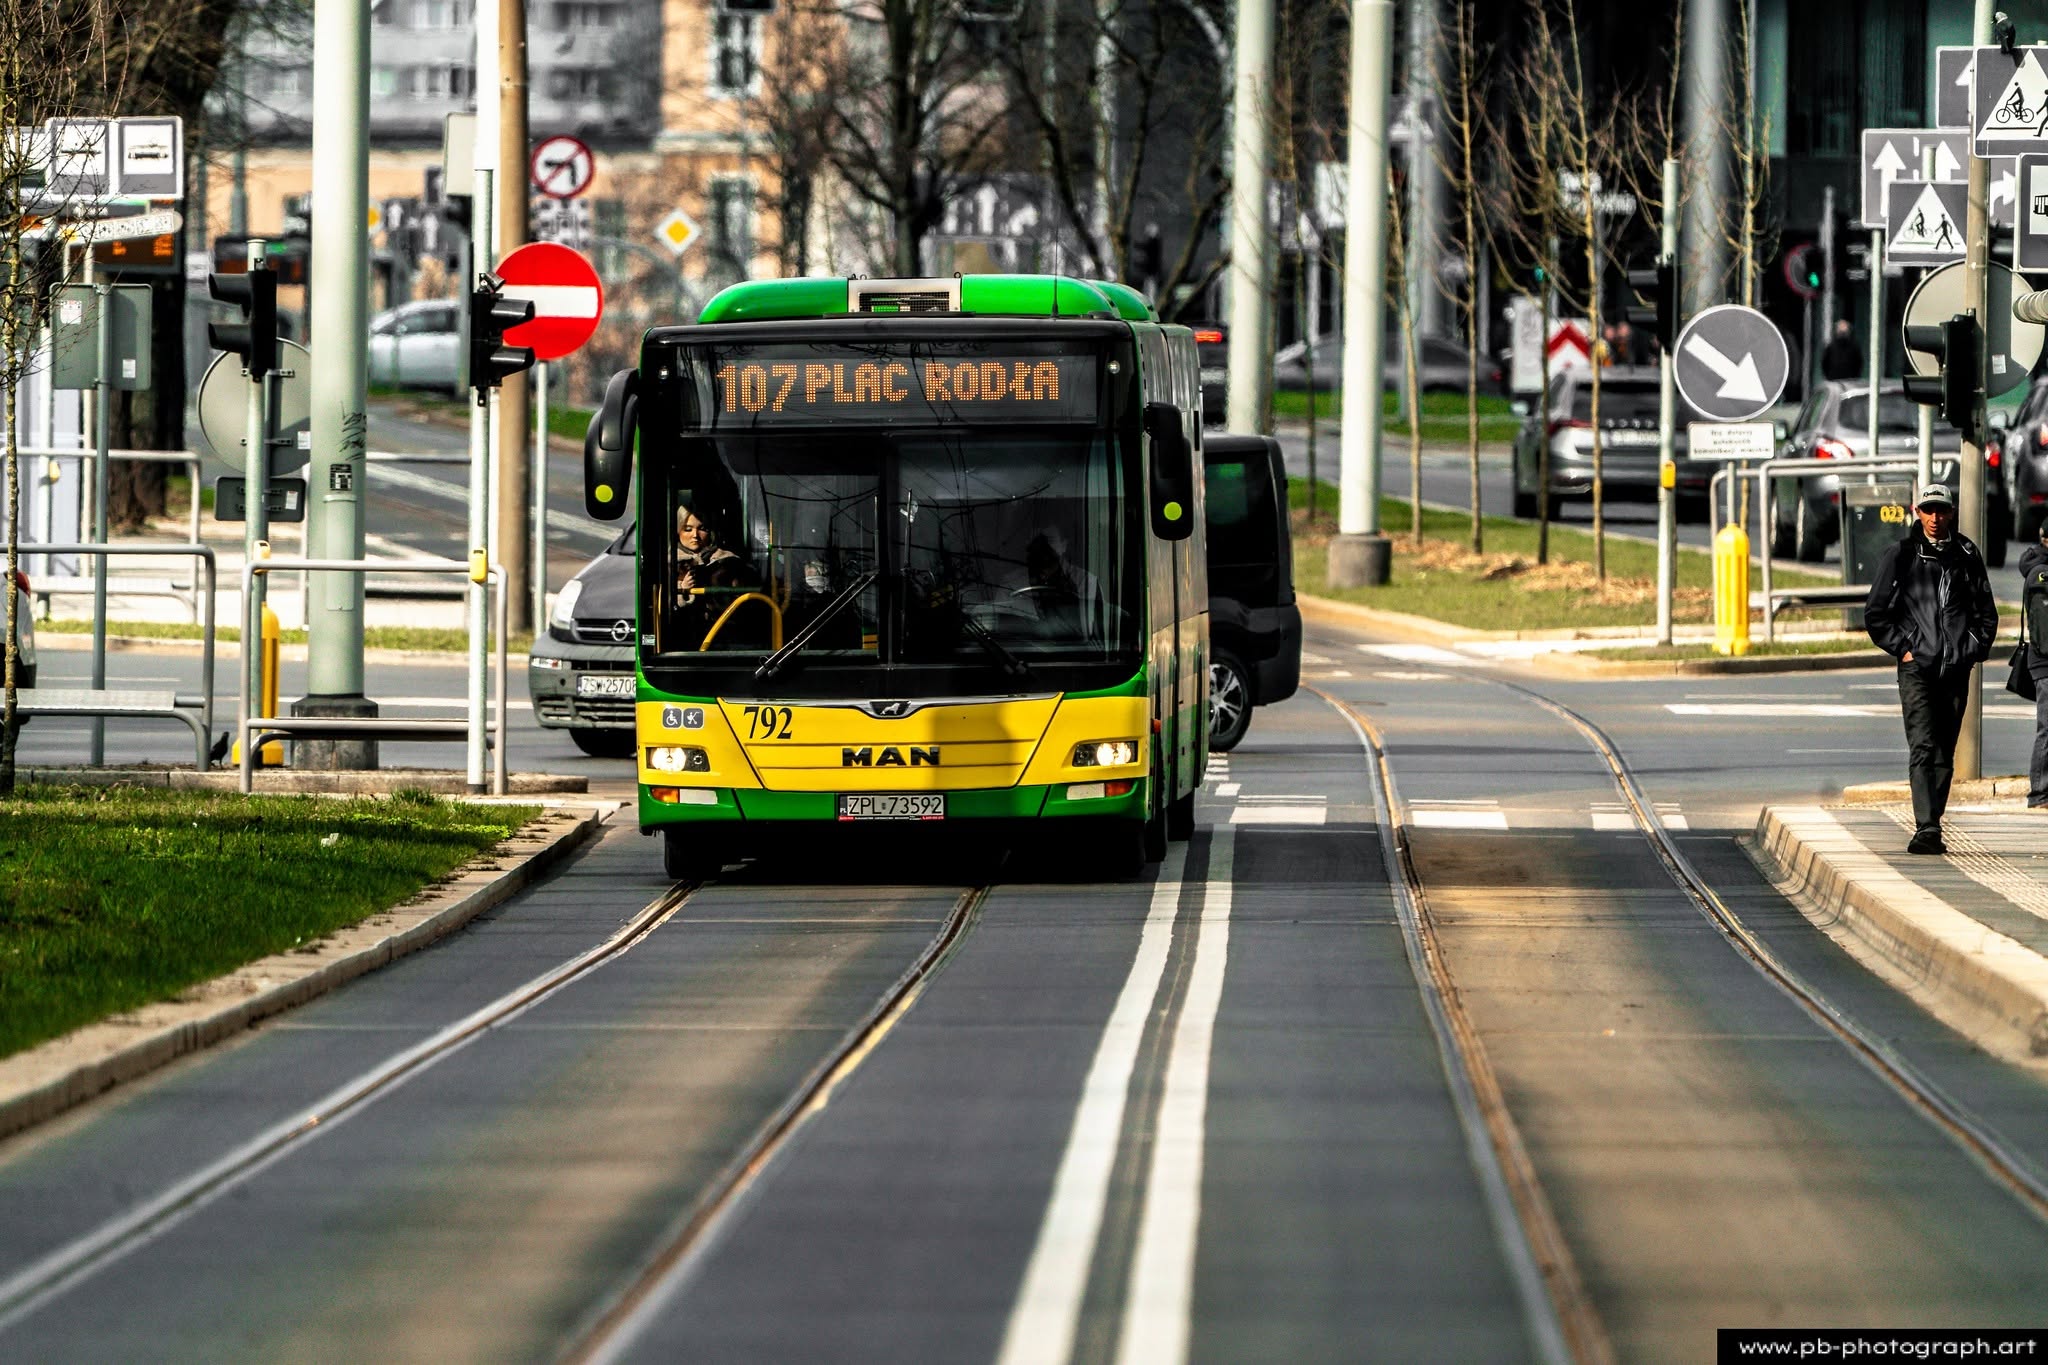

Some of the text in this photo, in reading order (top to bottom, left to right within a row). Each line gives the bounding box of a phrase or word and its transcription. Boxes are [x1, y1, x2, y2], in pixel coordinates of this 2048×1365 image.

[716, 361, 1059, 412] 107 PLAC RODŁA
[1880, 505, 1905, 523] 023
[743, 706, 793, 740] 792
[841, 746, 941, 767] MAN
[848, 796, 942, 815] ZPL 73592
